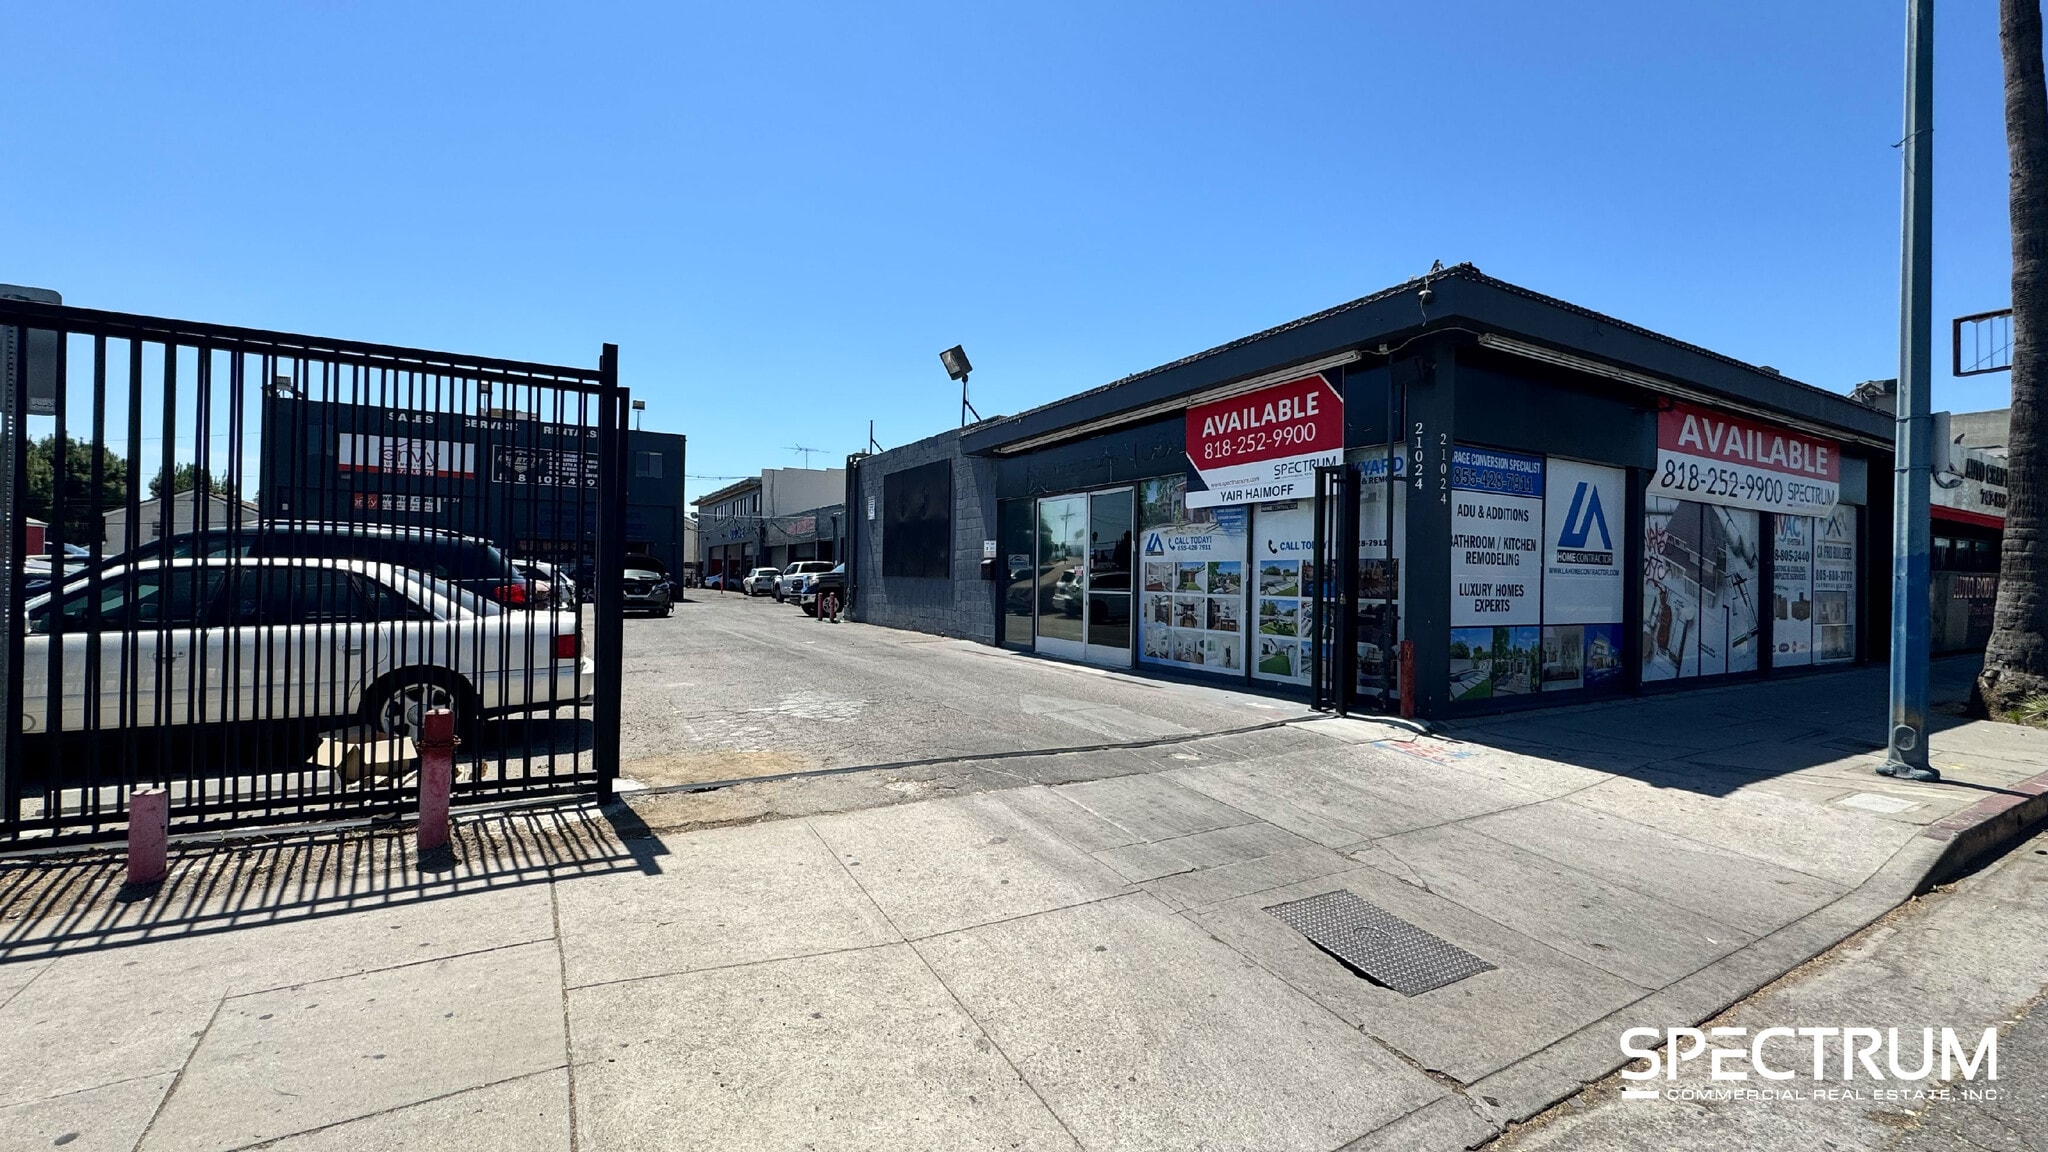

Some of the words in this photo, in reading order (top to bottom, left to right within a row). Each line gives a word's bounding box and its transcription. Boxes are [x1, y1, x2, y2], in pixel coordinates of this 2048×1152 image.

[1201, 391, 1320, 438] AVAILABLE
[1204, 422, 1317, 460] 818-252-9900
[1677, 413, 1828, 476] AVAILABLE
[1274, 455, 1337, 477] SPECTRUM
[1414, 421, 1424, 490] 21024
[1470, 452, 1509, 469] CONVERSION
[1509, 459, 1541, 474] SPECIALIST
[1439, 432, 1447, 505] 21024
[1454, 466, 1534, 493] 855-428-7911
[1220, 488, 1243, 502] YAIR
[1245, 483, 1295, 500] HAIMOFF
[1660, 458, 1783, 505] 818-252-9900
[1787, 482, 1836, 507] SPECTRUM
[1457, 503, 1476, 518] ADU
[1477, 507, 1485, 519] &
[1486, 506, 1529, 522] ADDITIONS
[1175, 536, 1190, 546] CALL
[1190, 535, 1213, 545] TODAY!
[1280, 540, 1300, 551] CALL
[1503, 537, 1537, 551] KITCHEN
[1465, 551, 1520, 566] REMODELING
[1557, 552, 1576, 562] HOME
[1576, 553, 1612, 564] CONTRACTOR
[1459, 582, 1493, 597] LUXURY
[1495, 584, 1525, 598] HOMES
[1954, 576, 1974, 599] AUTO
[1474, 599, 1511, 612] EXPERTS
